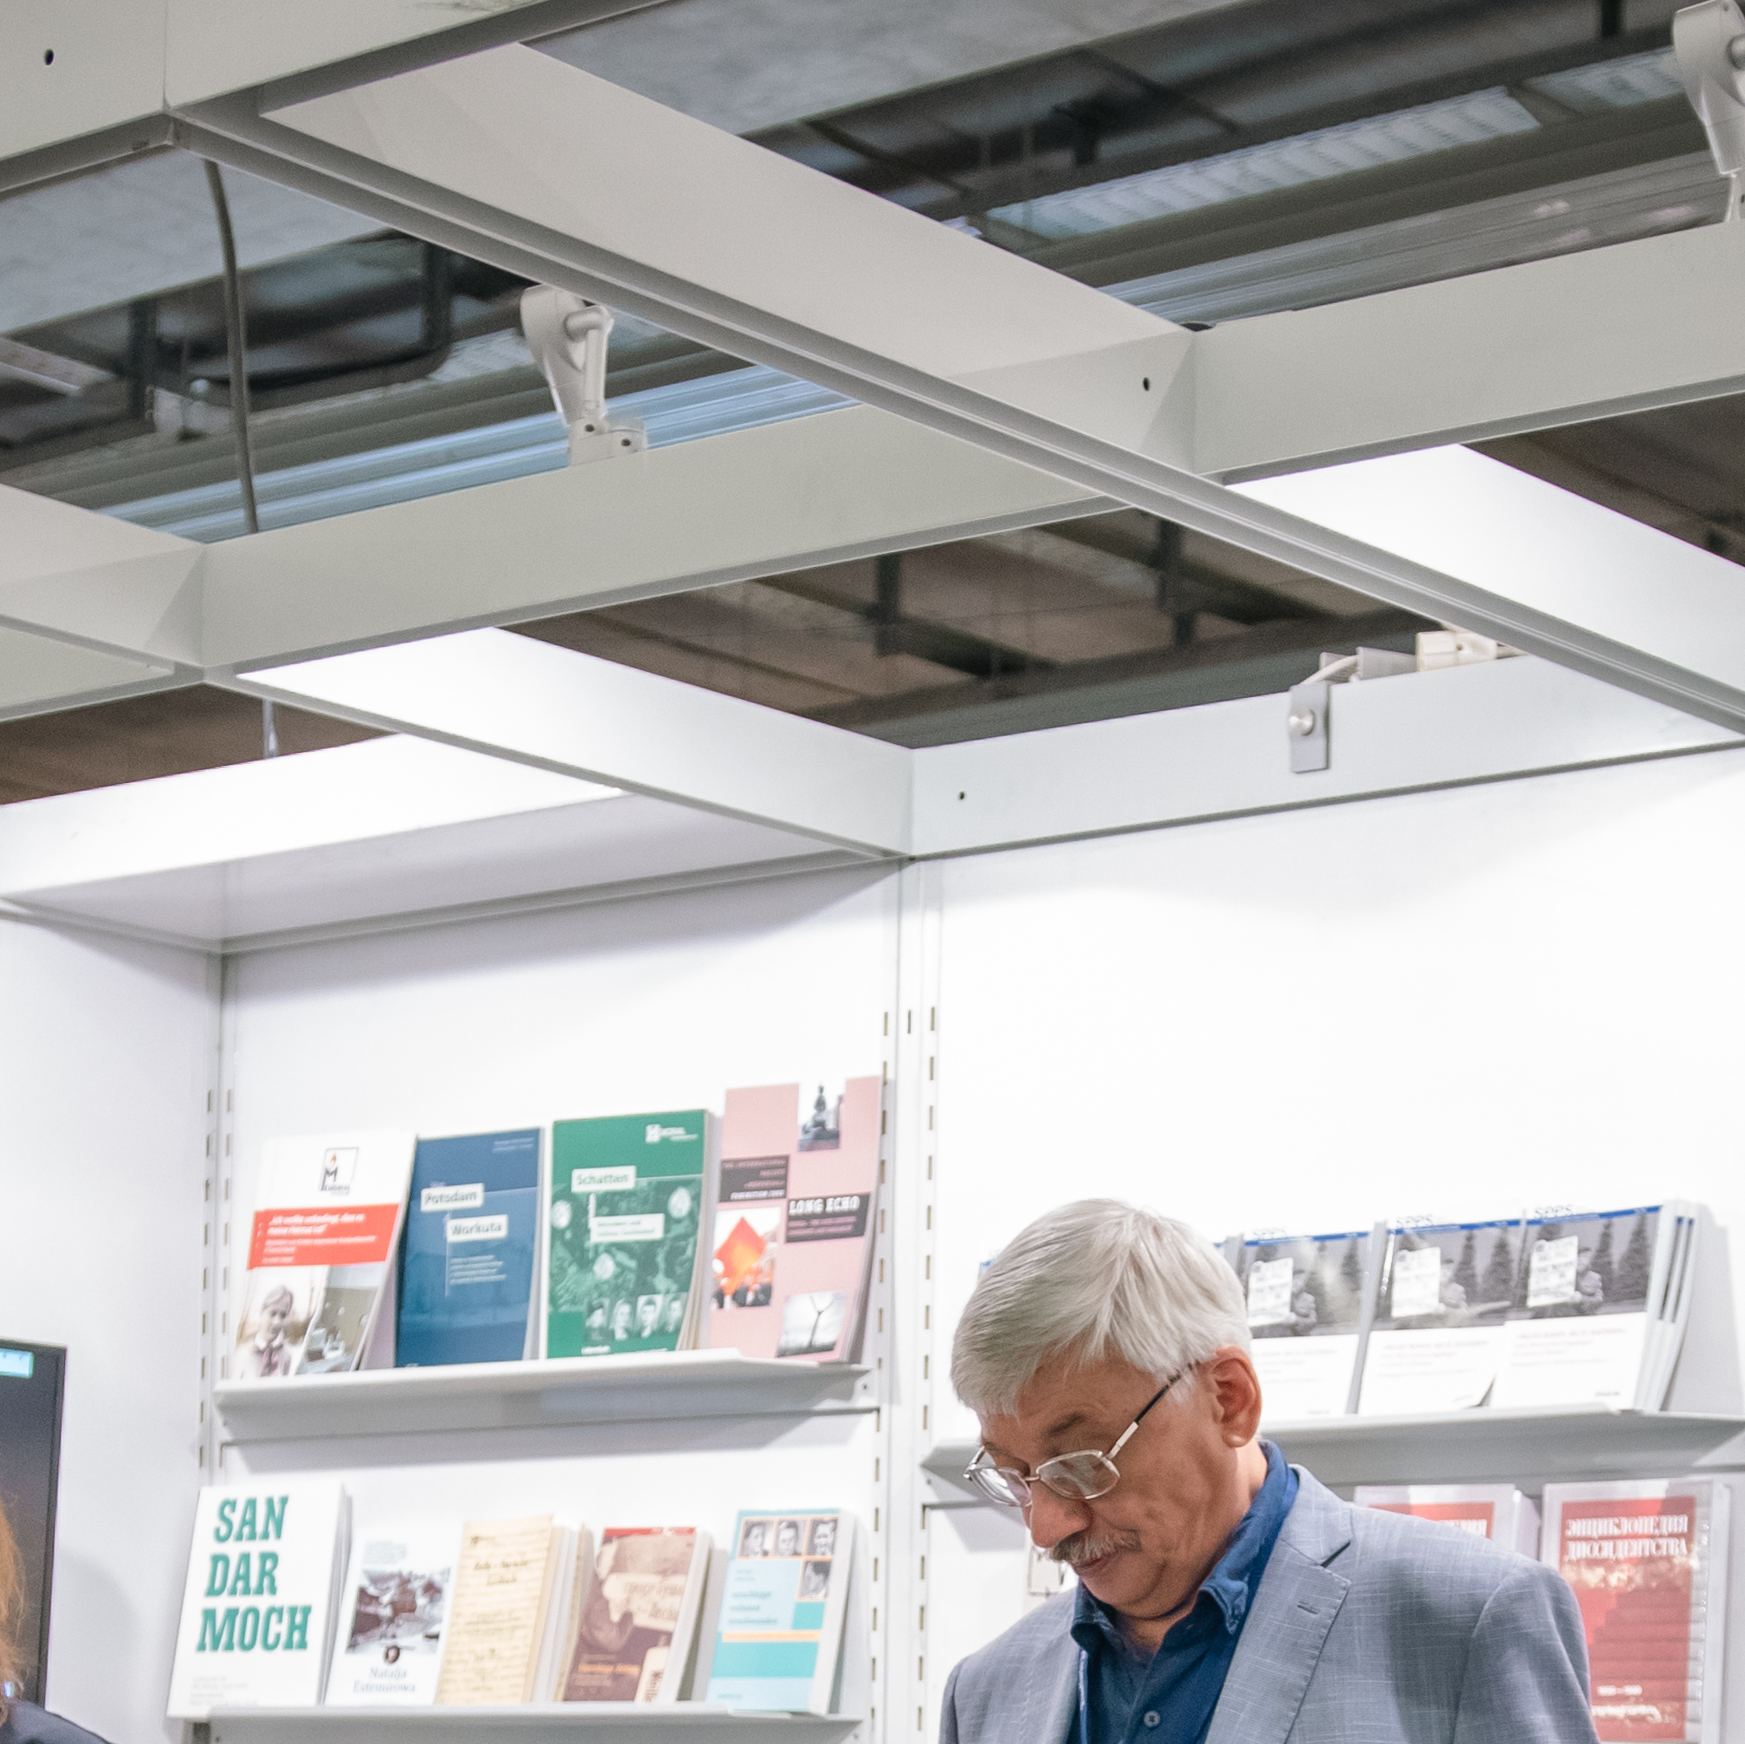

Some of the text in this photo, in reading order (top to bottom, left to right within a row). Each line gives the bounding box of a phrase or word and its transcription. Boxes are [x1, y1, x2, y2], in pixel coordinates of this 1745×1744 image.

[213, 1495, 289, 1543] SAN
[204, 1552, 279, 1598] DAR
[195, 1605, 312, 1653] MOCH
